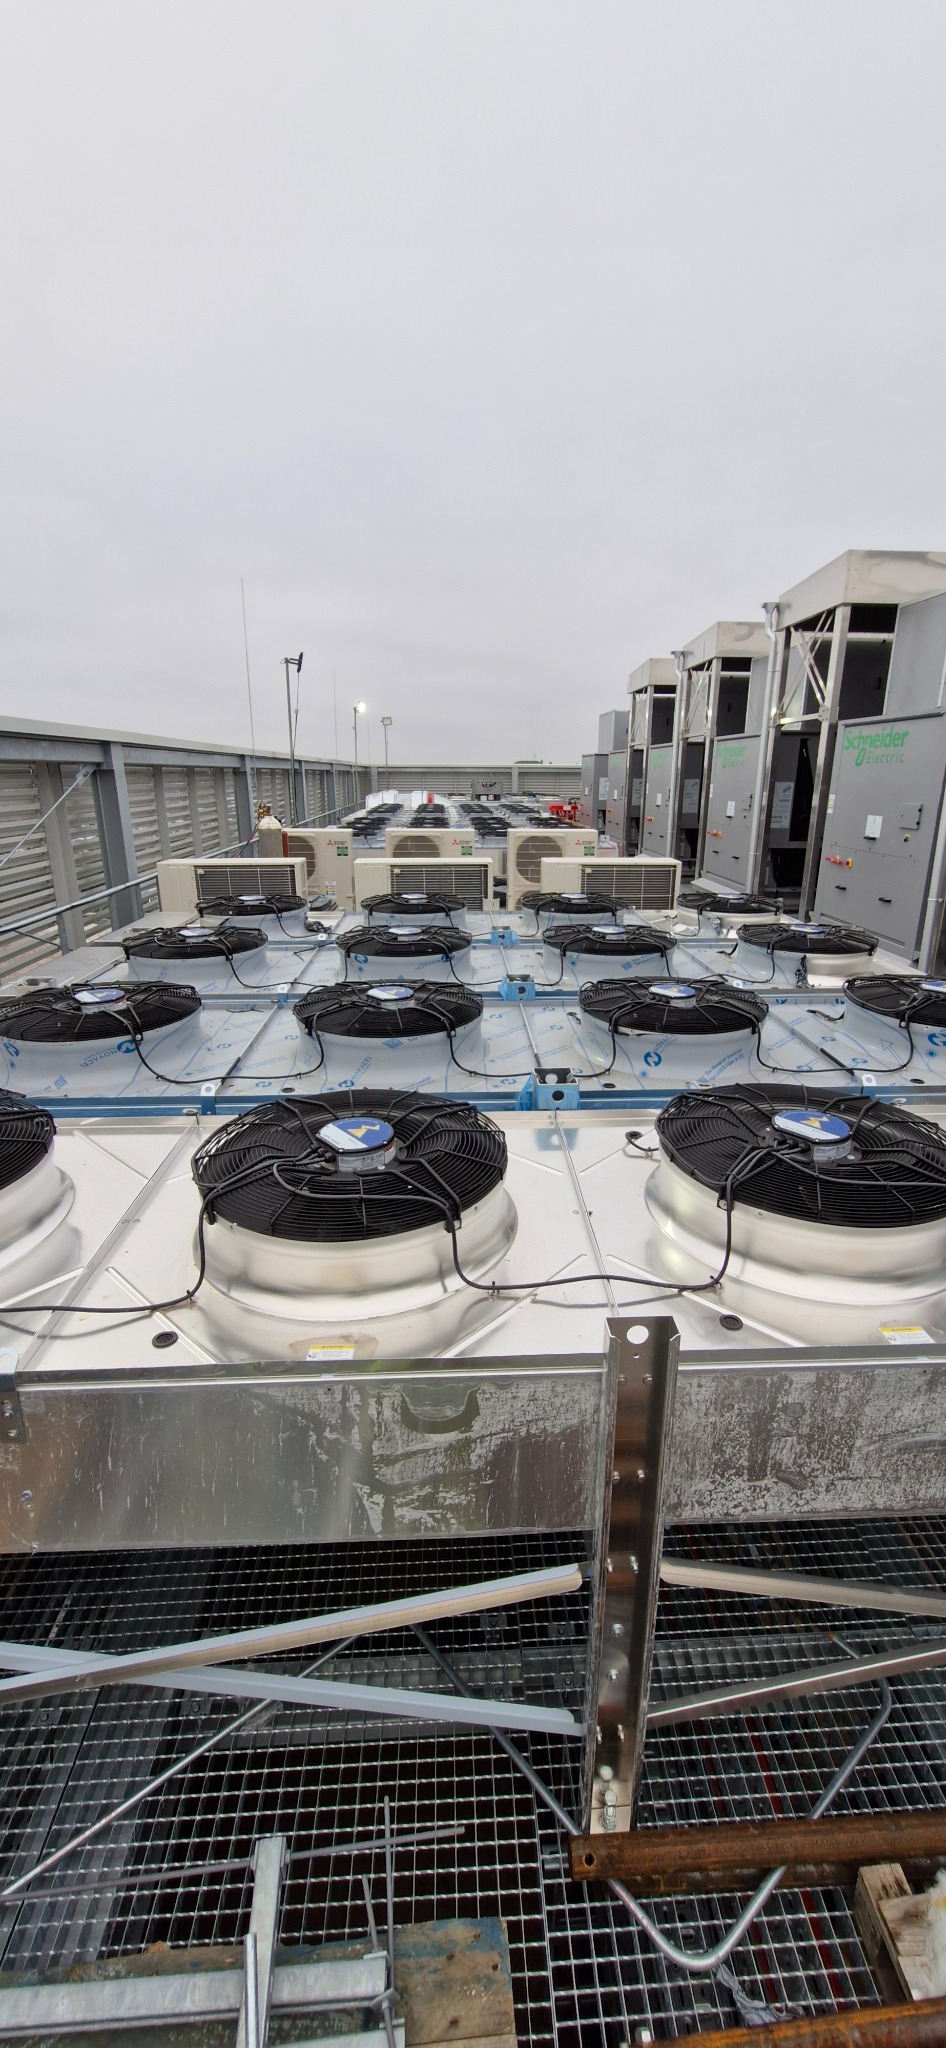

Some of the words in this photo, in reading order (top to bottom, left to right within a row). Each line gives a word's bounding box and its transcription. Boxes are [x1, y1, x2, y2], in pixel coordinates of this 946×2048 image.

[844, 726, 909, 750] Schneider
[866, 750, 904, 764] Electric
[80, 1047, 117, 1070] NOVACEL
[351, 1055, 373, 1080] NOVACEL
